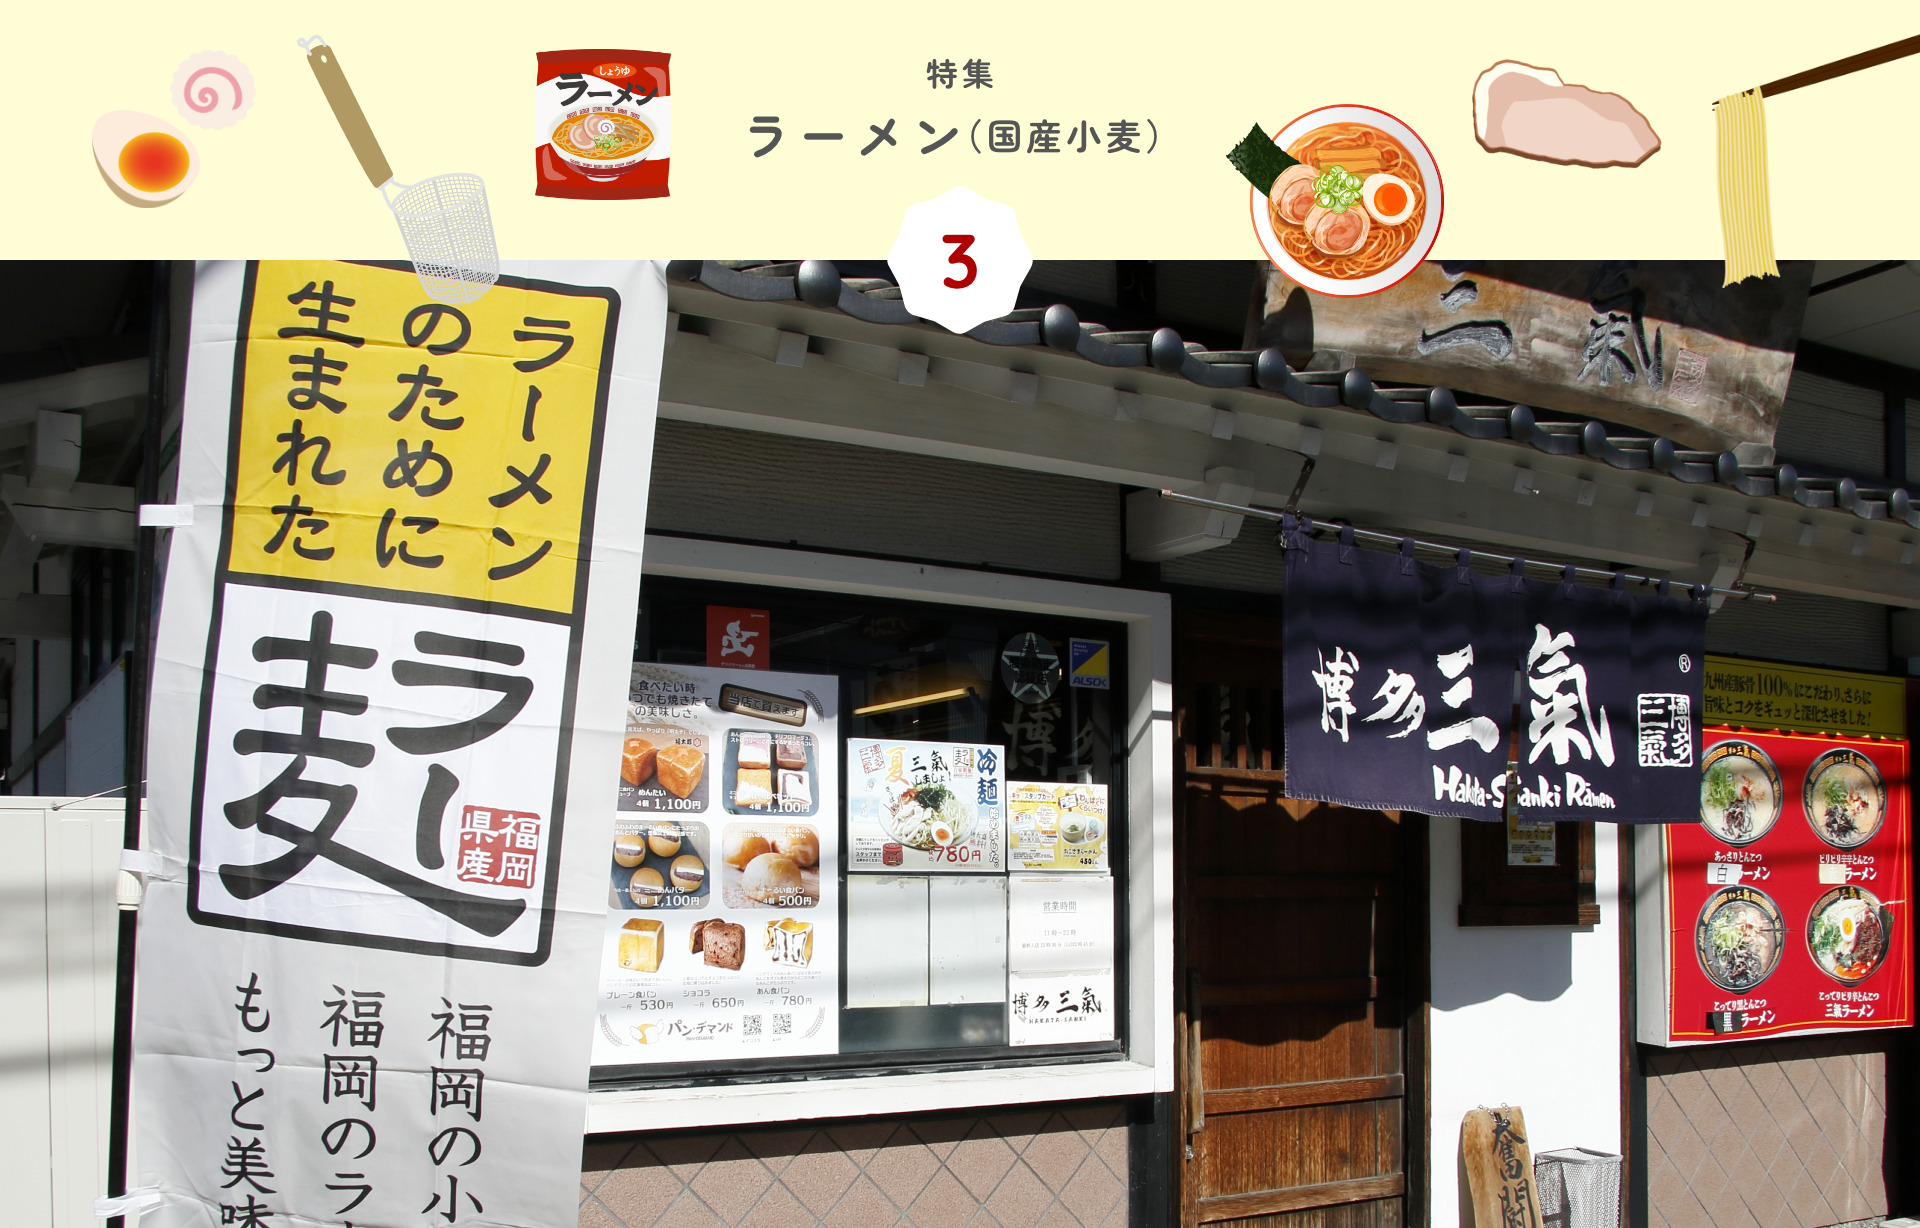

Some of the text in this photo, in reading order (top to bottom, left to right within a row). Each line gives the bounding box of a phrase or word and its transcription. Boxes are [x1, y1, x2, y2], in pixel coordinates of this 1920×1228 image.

[263, 280, 365, 561] 生まれた
[376, 303, 472, 569] のために
[488, 316, 575, 581] ラーメン
[638, 679, 696, 693] 食べたい時
[1072, 676, 1107, 687] ALSOK
[1312, 623, 1615, 767] 博多三氣
[728, 691, 800, 718] 当店で買えます
[635, 706, 700, 720] の美味しさ。
[885, 746, 909, 786] 夏
[910, 749, 948, 773] 三氣
[638, 788, 667, 797] めんたい
[654, 798, 701, 811] 1,100円
[766, 801, 810, 813] 1,100円
[988, 807, 1000, 869] 始めました。
[934, 845, 982, 863] 780円
[1714, 850, 1762, 863] あっさりとんこつ
[653, 895, 700, 906] 1,100円
[778, 895, 812, 906] 500円
[1043, 900, 1077, 911] 営業時間
[606, 990, 657, 1000] プレーン食パン
[683, 989, 711, 997] ショコラ
[756, 986, 790, 995] あん食パン
[1819, 991, 1880, 1003] こってりピリ辛とんこつ
[640, 999, 674, 1010] 530円
[712, 997, 745, 1008] 650円
[781, 995, 812, 1006] 780円
[1012, 986, 1102, 1016] 博多三氣
[1714, 999, 1767, 1011] こってり黒とんこつ
[1825, 1003, 1875, 1019] 三氣ラーメン
[1029, 1016, 1087, 1024] HAKATA-SANKI
[220, 972, 279, 1228] もっと美味
[320, 984, 386, 1228] 福岡のラ
[421, 996, 493, 1223] 福岡の小
